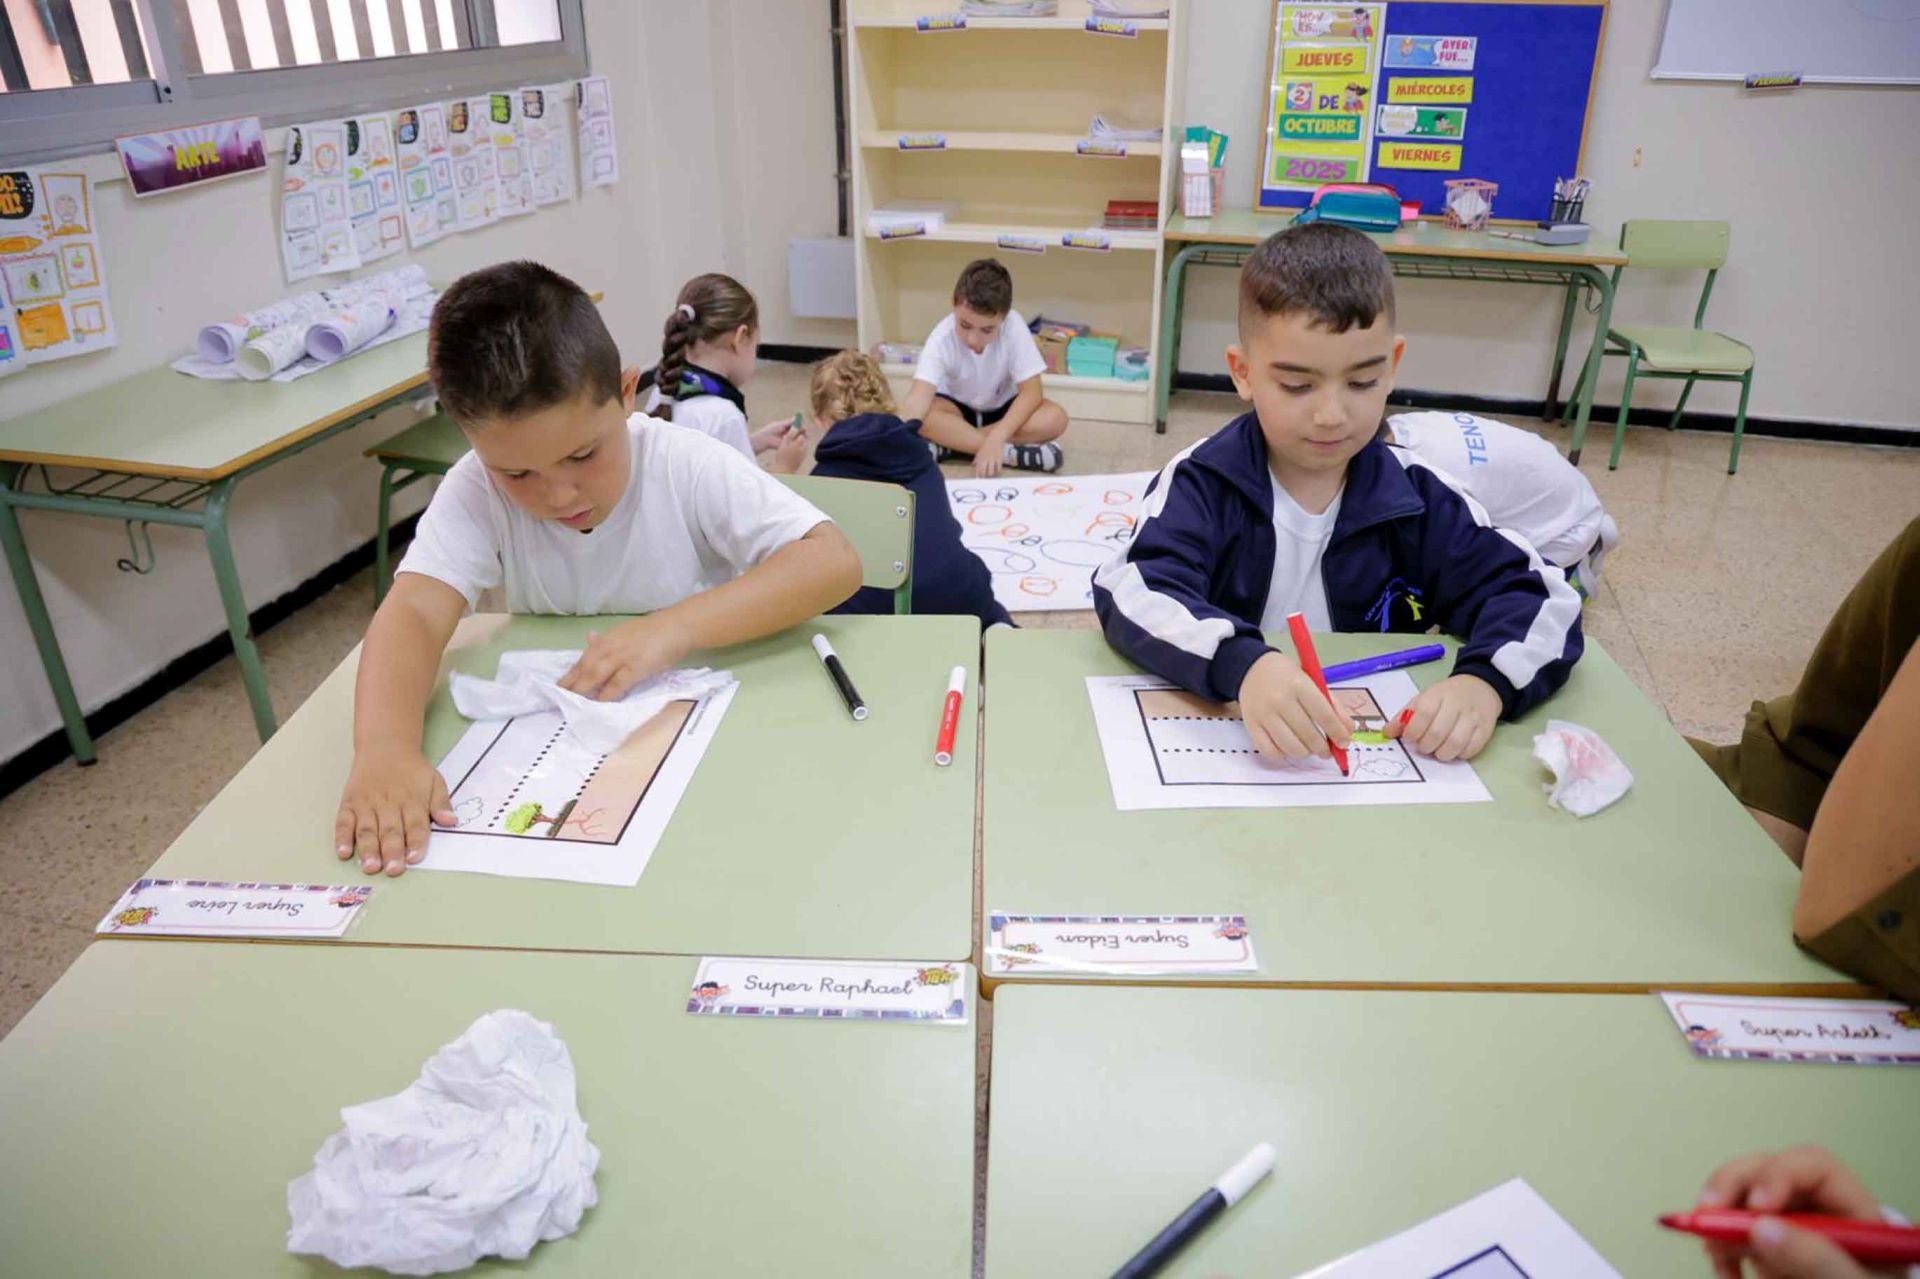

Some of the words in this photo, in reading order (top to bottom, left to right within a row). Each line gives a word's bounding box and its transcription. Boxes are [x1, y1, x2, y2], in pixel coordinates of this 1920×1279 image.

[1441, 39, 1469, 50] AYER
[1295, 52, 1353, 66] JUEVES
[1395, 80, 1466, 96] MIÉRCOLES
[1294, 89, 1305, 102] 2
[1318, 94, 1339, 110] DE
[1284, 118, 1356, 133] OCTUBRE
[175, 142, 220, 171] ARTE
[1392, 148, 1451, 163] VIERNES
[1285, 158, 1346, 180] 2025
[186, 899, 237, 916] Leire
[242, 897, 303, 916] Super
[1055, 935, 1119, 949] Eidan
[1124, 930, 1189, 949] Super
[743, 975, 813, 998] Super
[819, 977, 914, 1000] Raphael
